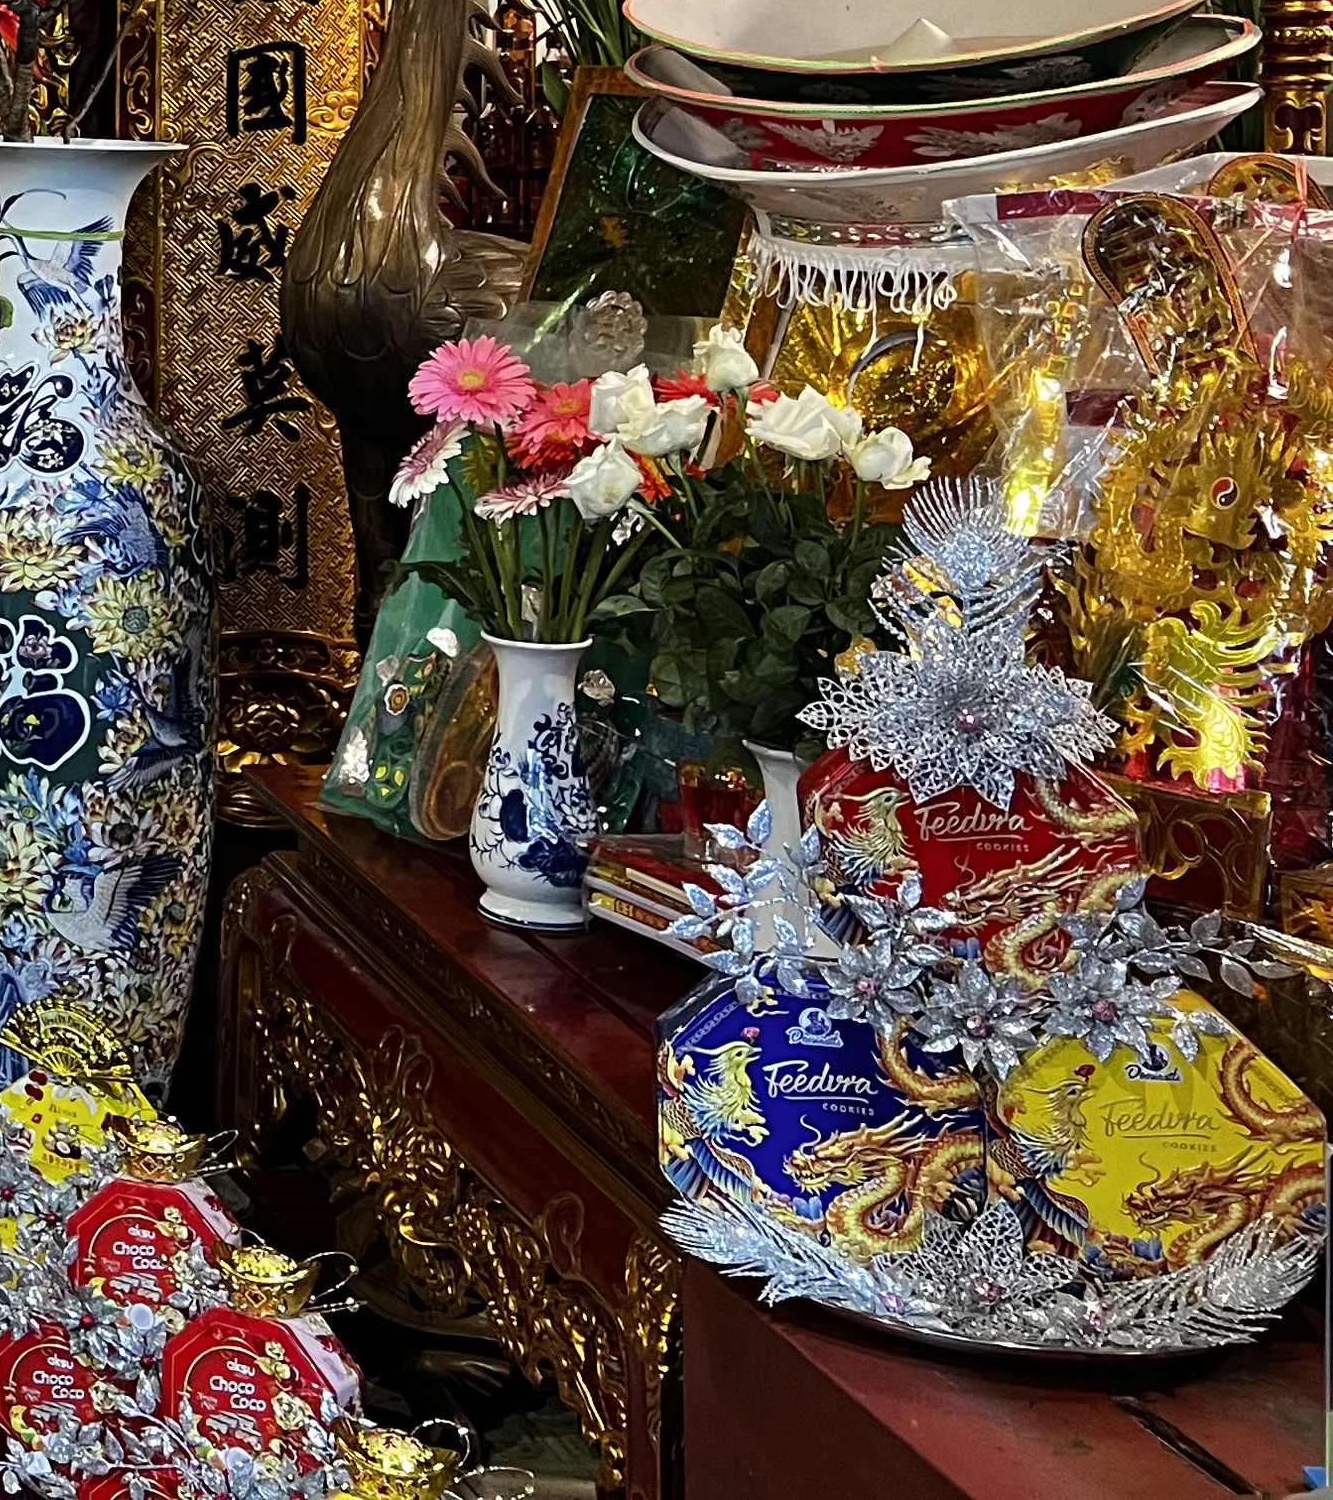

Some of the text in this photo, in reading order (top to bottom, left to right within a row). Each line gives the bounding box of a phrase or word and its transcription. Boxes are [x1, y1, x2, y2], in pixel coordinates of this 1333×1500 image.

[113, 1241, 156, 1256] Choco
[33, 1370, 74, 1386] Choco
[209, 1375, 256, 1395] Choco
[51, 1385, 85, 1400] Coco
[229, 1393, 267, 1412] Coco
